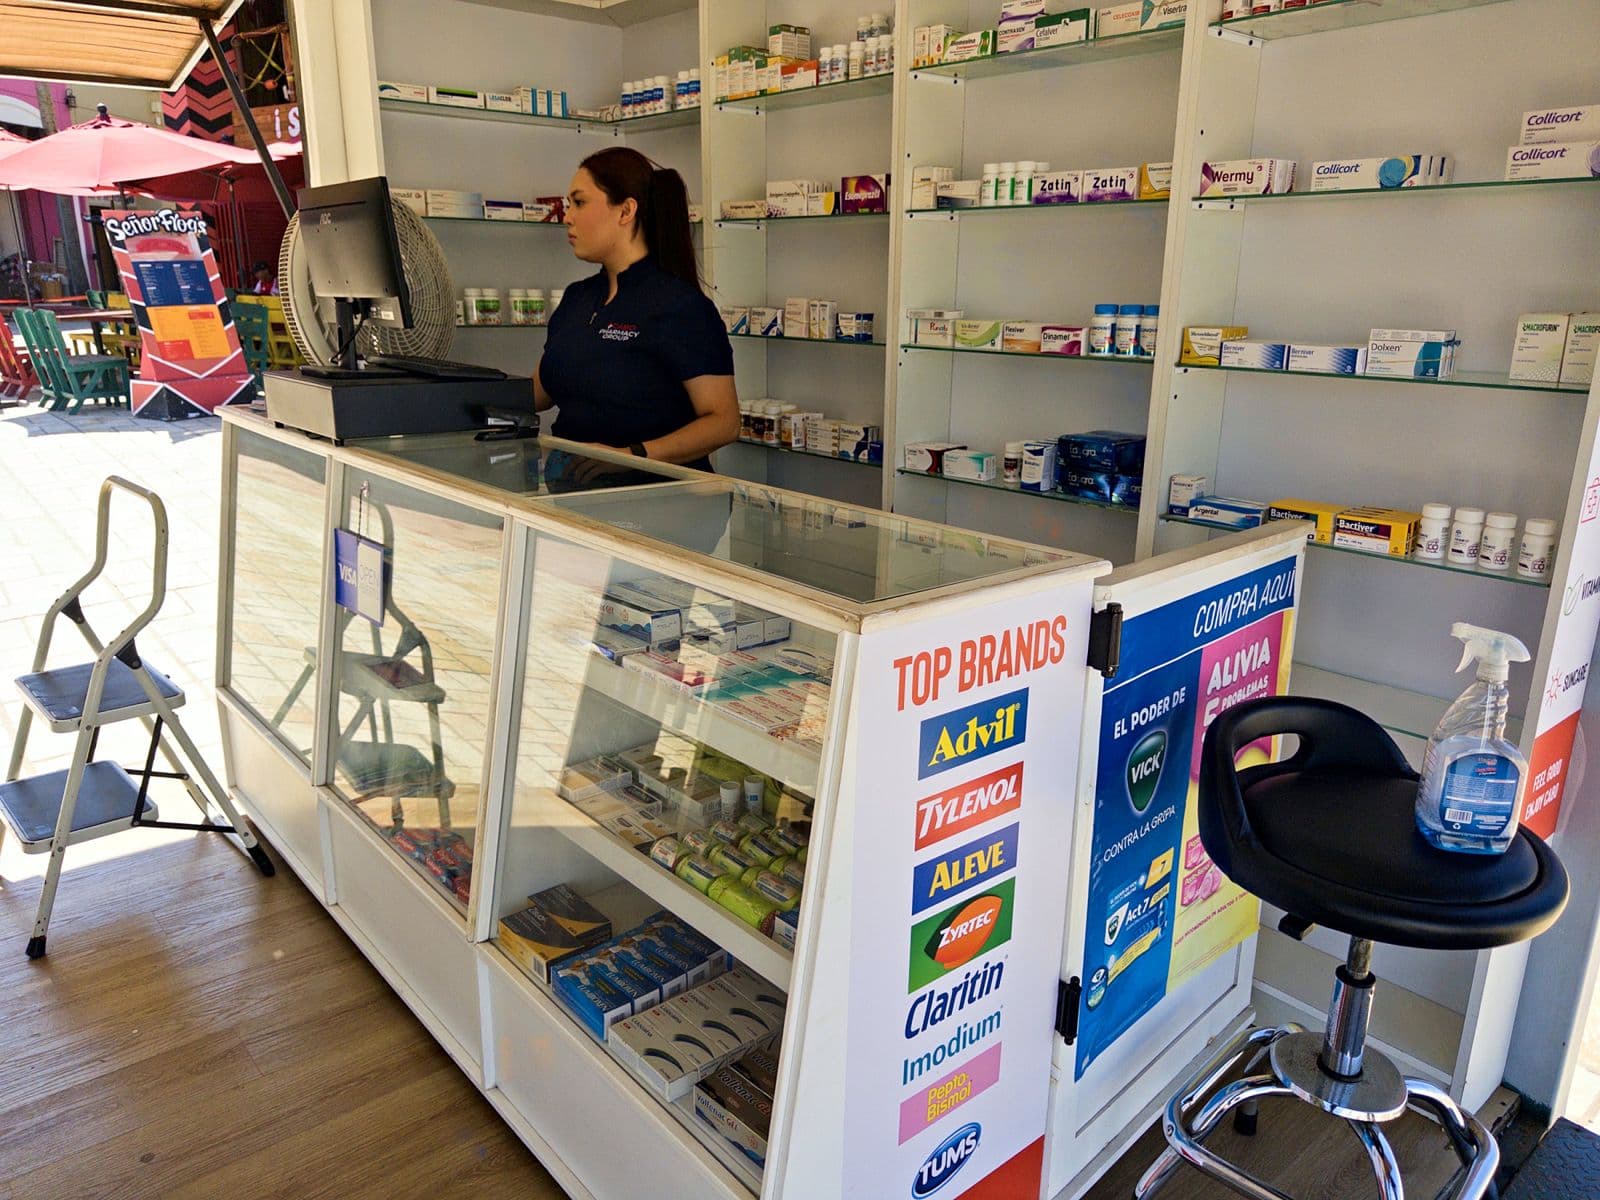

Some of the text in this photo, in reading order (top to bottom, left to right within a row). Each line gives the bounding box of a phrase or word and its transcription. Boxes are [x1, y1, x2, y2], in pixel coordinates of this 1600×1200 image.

[1527, 111, 1583, 126] Collicort
[1316, 163, 1361, 175] Collicort
[1512, 147, 1568, 161] Collicort
[1212, 170, 1254, 184] Wermy
[1339, 519, 1375, 533] Bactiver
[337, 562, 357, 587] VISA
[1193, 583, 1258, 638] COMPRA
[893, 614, 1067, 712] TOP BRANDS
[1206, 637, 1271, 696] ALIVIA
[1113, 687, 1186, 740] EL PODER DE
[1221, 675, 1269, 711] PROBLEMAS
[927, 703, 1017, 767] Advil
[1131, 750, 1162, 784] VICK
[1533, 770, 1547, 793] FEEL
[918, 774, 1017, 839] TYLENOL
[1525, 795, 1544, 821] ENJOY
[1104, 805, 1176, 862] CONTRA LA GRIPA
[928, 840, 1005, 898] ALEVE
[938, 908, 993, 949] ZYRTEC
[904, 961, 1004, 1040] Claritin
[903, 1010, 1001, 1085] Imodium
[926, 1081, 973, 1122] Bismol
[919, 1131, 977, 1186] TUMS
